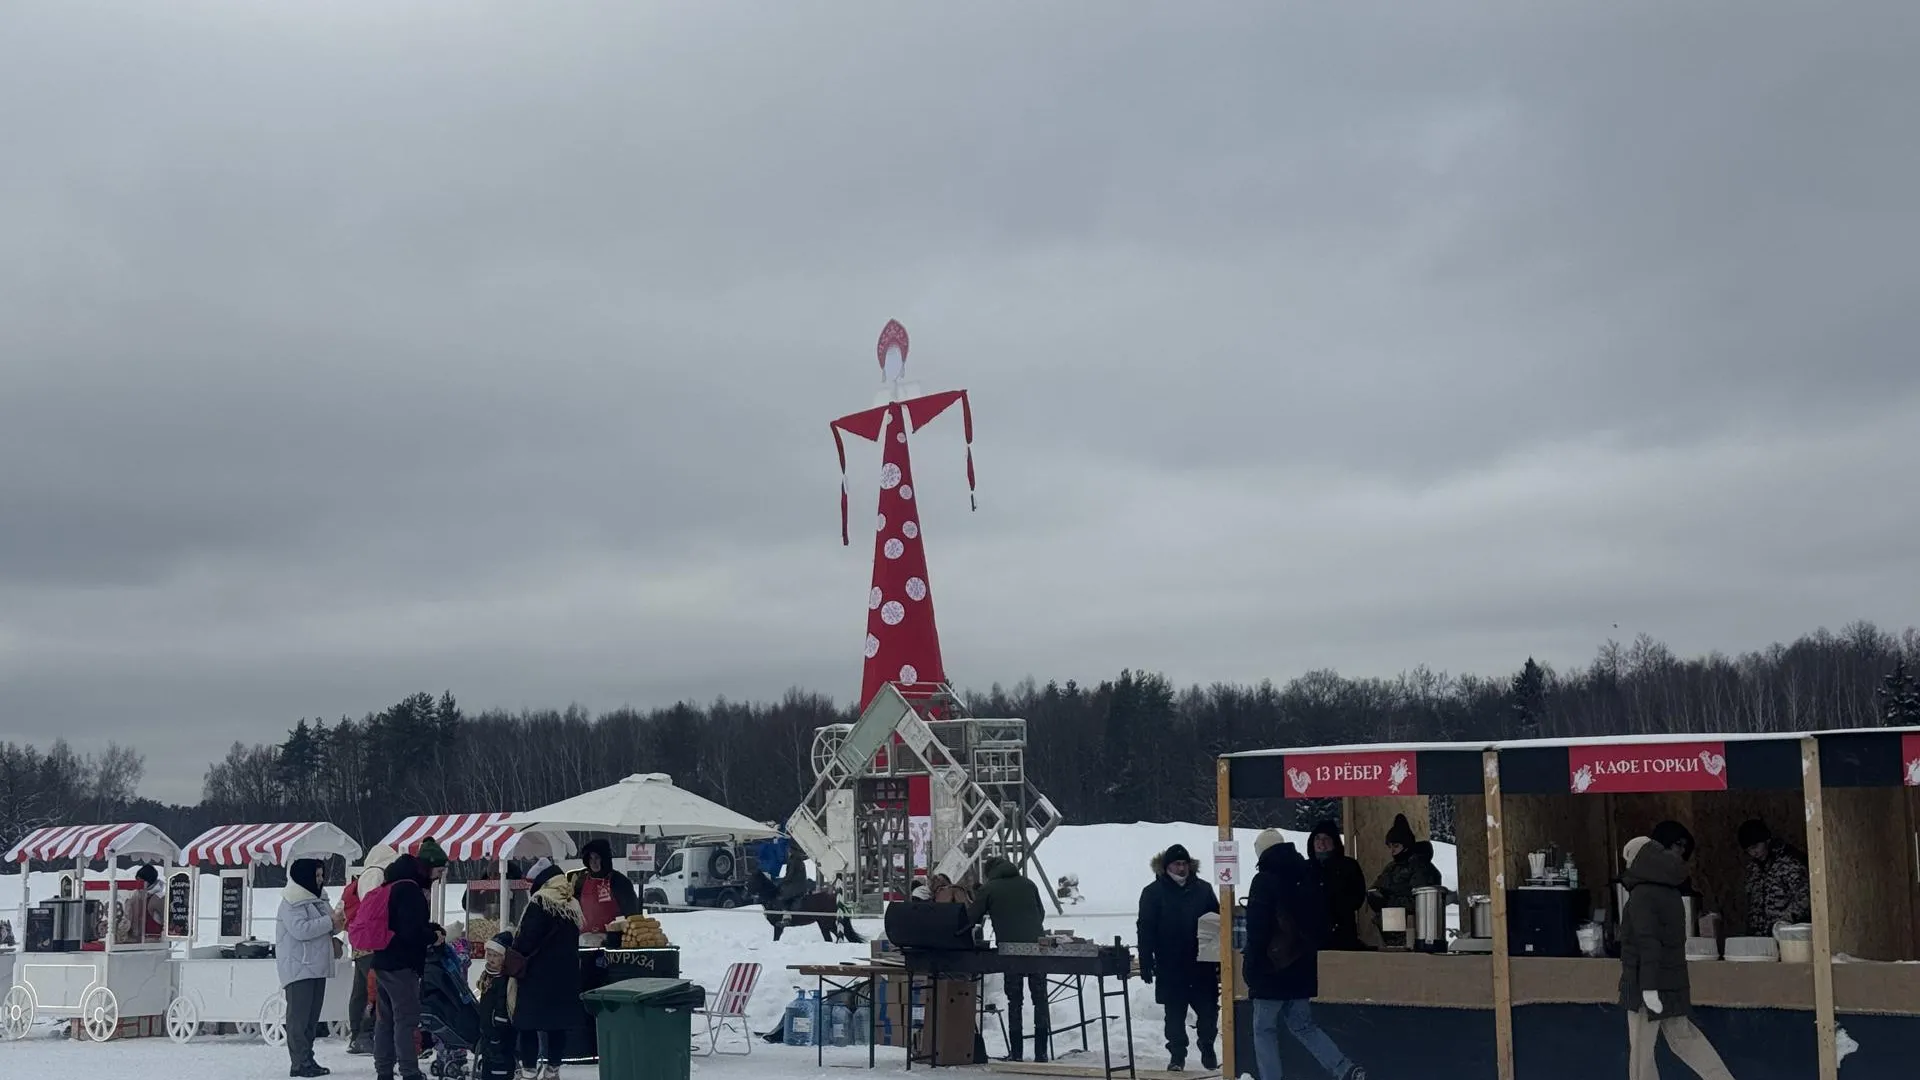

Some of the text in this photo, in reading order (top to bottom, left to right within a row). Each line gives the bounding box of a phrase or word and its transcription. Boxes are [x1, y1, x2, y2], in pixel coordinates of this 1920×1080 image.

[1316, 762, 1383, 781] 13 РЁБЕР
[1595, 757, 1699, 774] КАФЕ ГОРКИ
